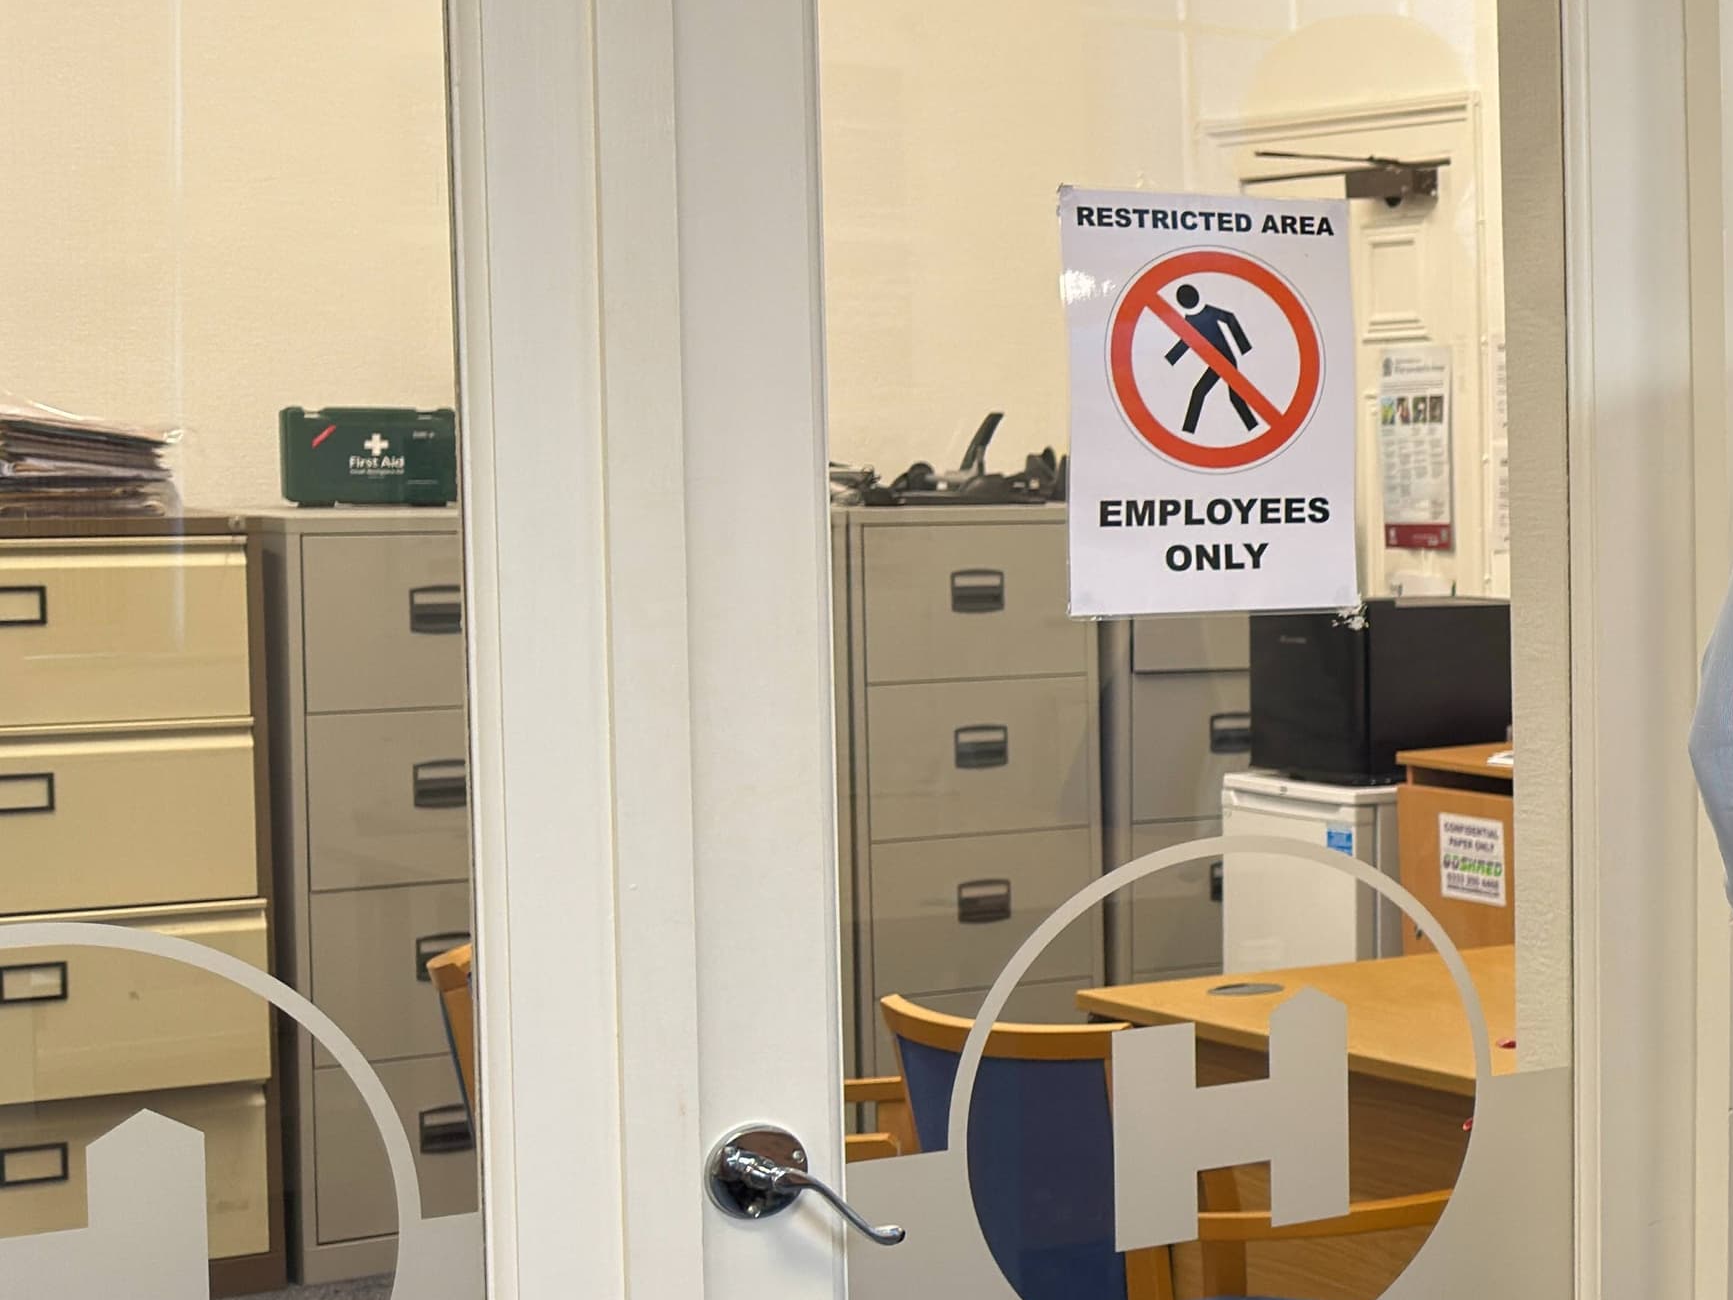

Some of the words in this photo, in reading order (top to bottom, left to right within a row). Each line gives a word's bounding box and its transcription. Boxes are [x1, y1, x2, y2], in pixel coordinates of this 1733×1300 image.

[1076, 206, 1251, 232] RESTRICTED
[1261, 214, 1334, 236] AREA
[349, 455, 377, 469] First
[381, 455, 405, 468] Aid
[1099, 497, 1330, 527] EMPLOYEES
[1165, 543, 1269, 571] ONLY
